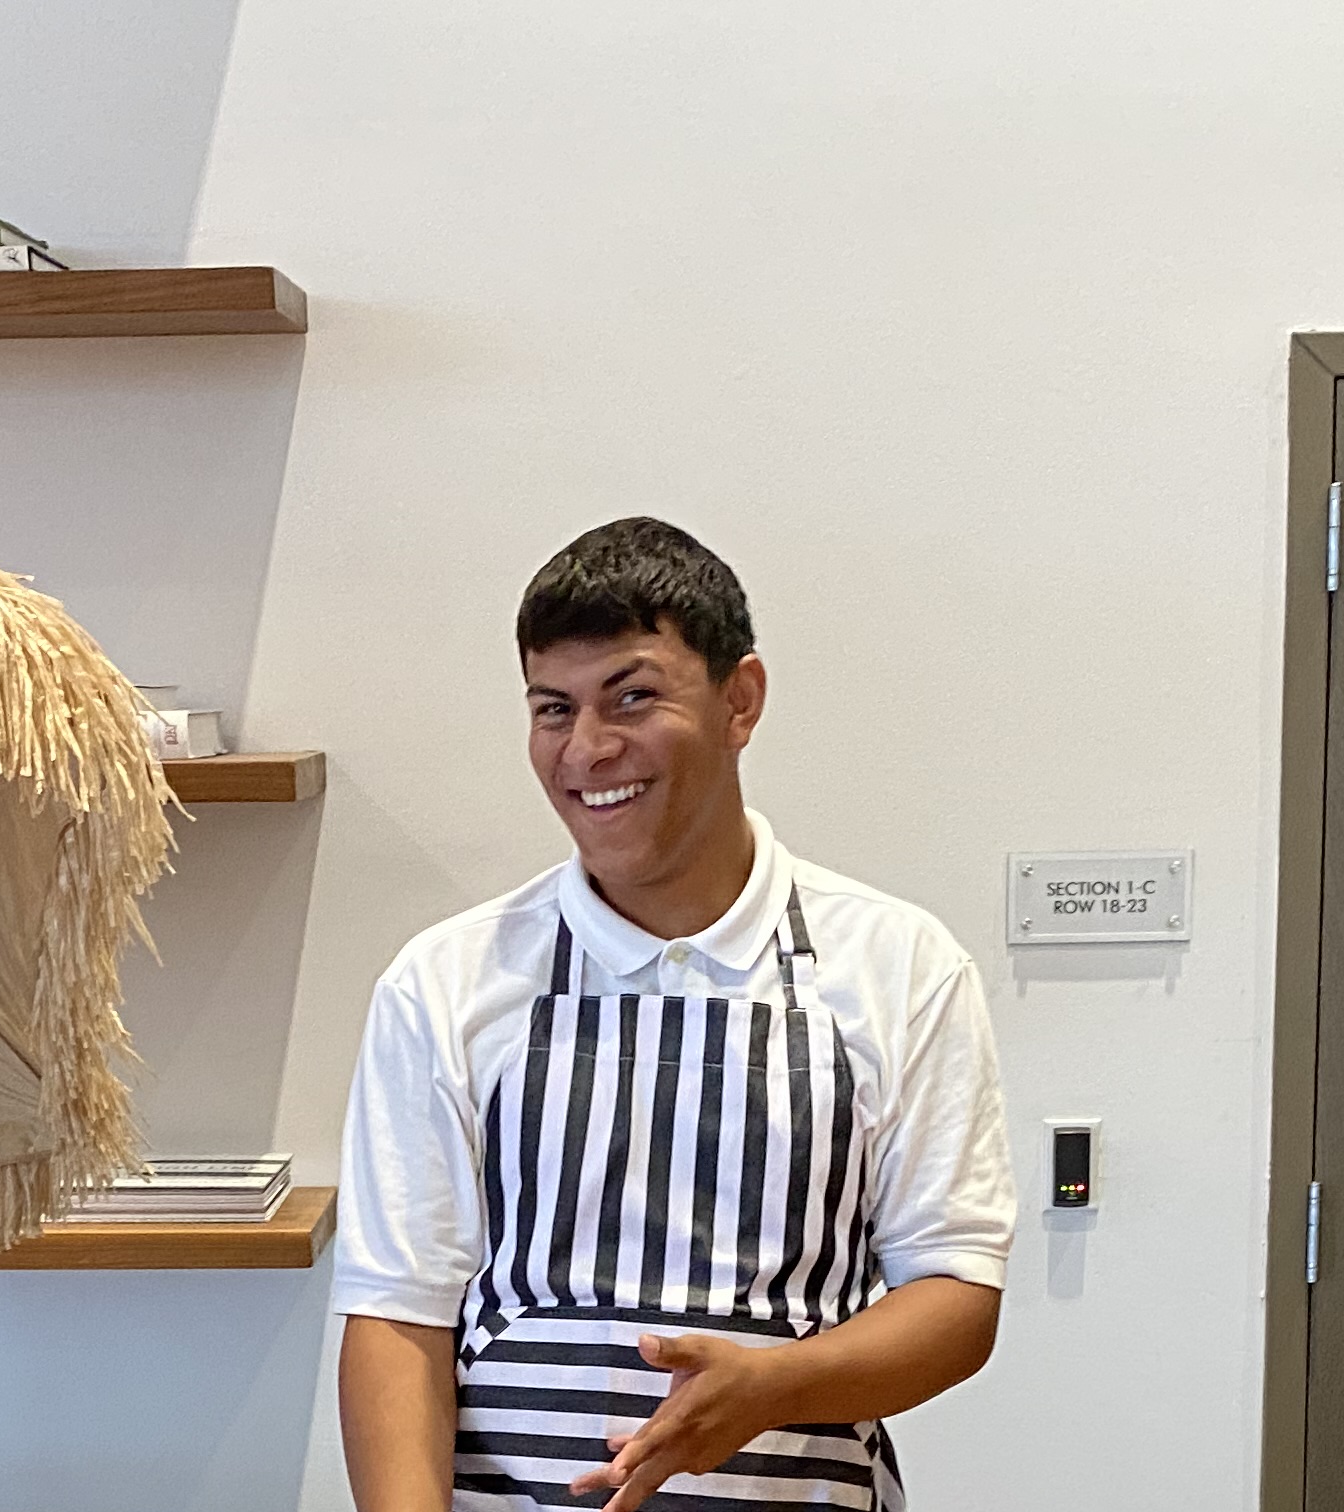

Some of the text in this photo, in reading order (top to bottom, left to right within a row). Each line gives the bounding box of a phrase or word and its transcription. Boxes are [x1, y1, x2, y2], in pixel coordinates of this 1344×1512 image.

[1047, 880, 1156, 896] SECTION 1-C
[1054, 898, 1147, 914] ROW 18-23
